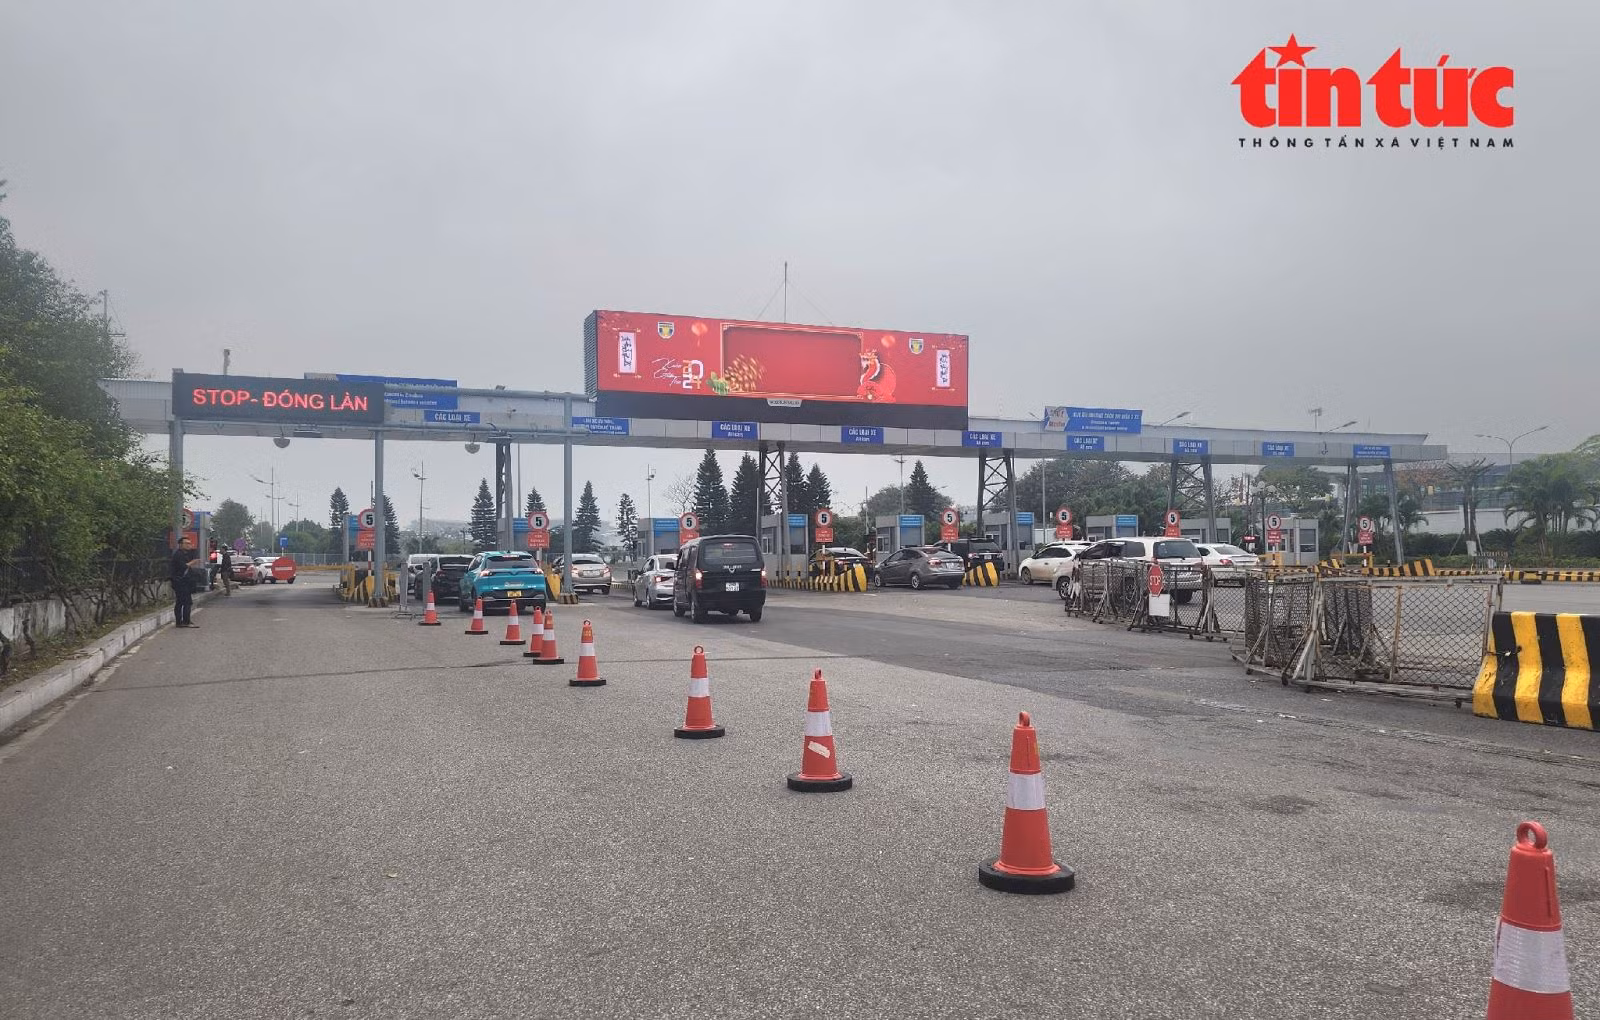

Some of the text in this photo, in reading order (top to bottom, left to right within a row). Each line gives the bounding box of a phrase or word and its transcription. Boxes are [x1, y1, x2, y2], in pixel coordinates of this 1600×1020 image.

[262, 389, 325, 410] ĐÓNG
[329, 392, 369, 411] LÀN
[366, 514, 374, 526] 5
[535, 516, 543, 527] 5
[821, 513, 827, 523] 5
[947, 513, 953, 523] 5
[1061, 512, 1067, 521] 5
[1170, 513, 1176, 524] 5
[1272, 517, 1277, 526] 5
[686, 517, 693, 528] 5
[1362, 519, 1368, 529] 5
[1149, 575, 1161, 586] STOP
